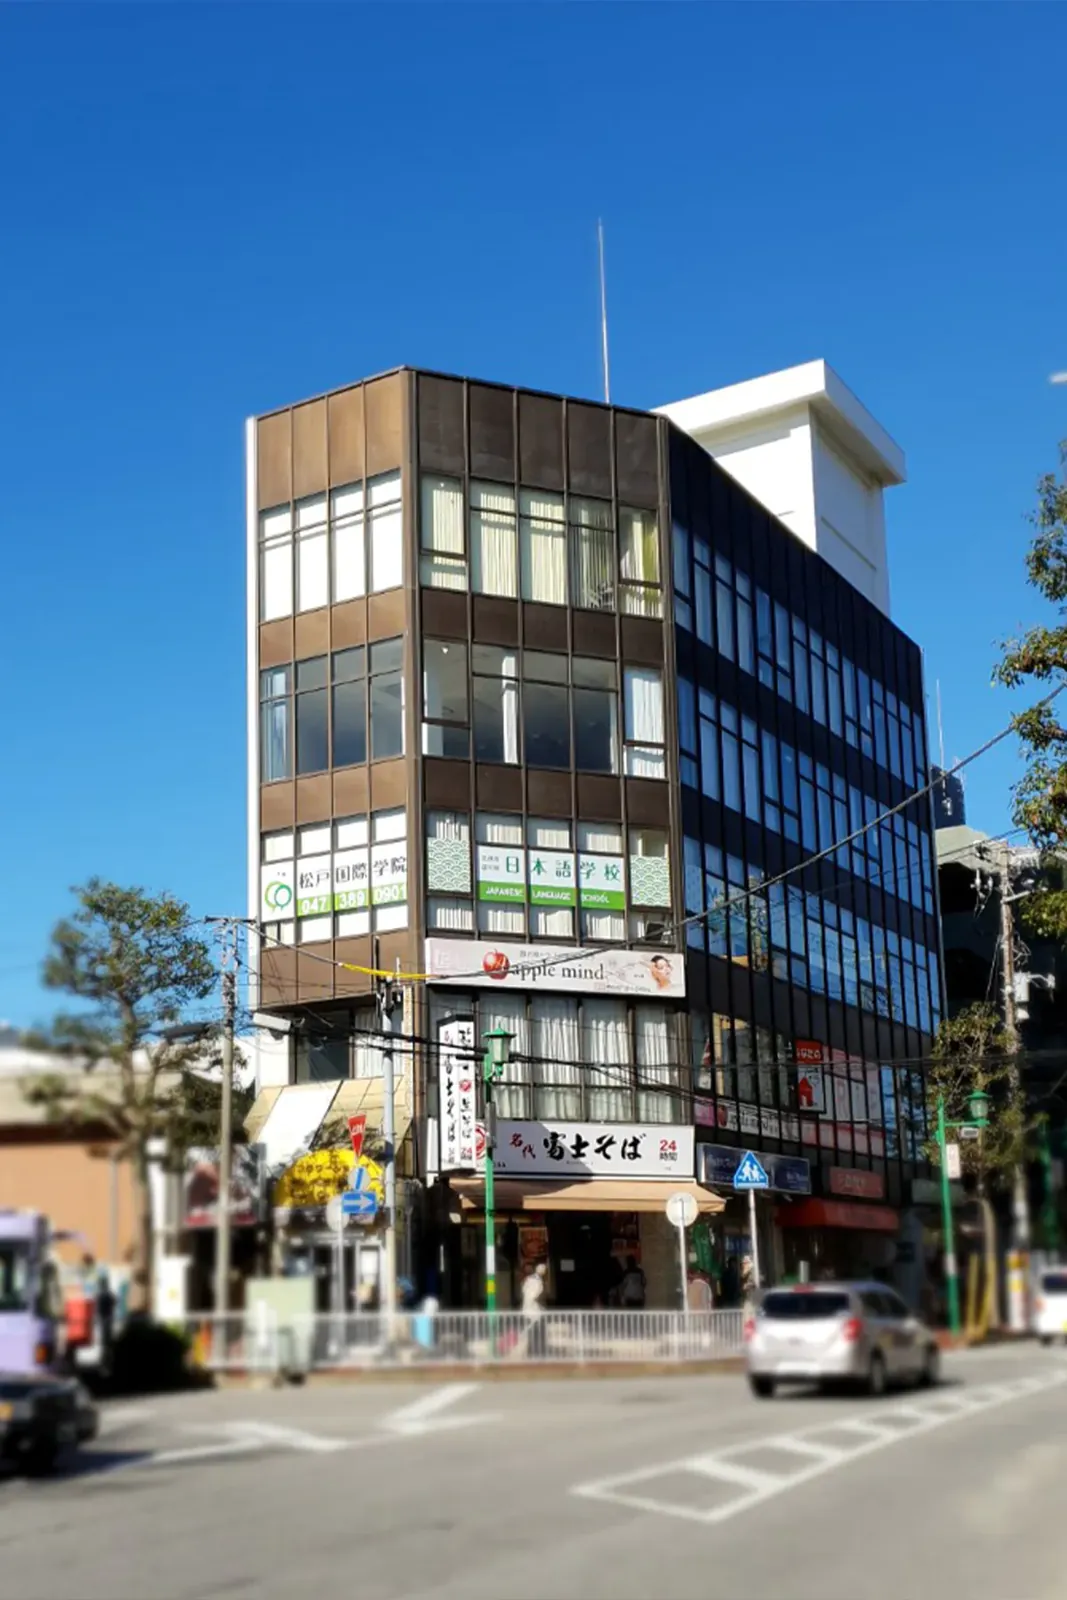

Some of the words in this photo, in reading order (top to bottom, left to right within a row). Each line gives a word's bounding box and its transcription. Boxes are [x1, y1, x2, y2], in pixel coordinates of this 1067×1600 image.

[299, 856, 407, 889] 松戸国際学院
[506, 855, 620, 881] 日本語学校
[301, 896, 328, 915] 047
[532, 890, 571, 901] LANGUAGE
[510, 957, 556, 982] apple
[561, 963, 604, 981] mind
[543, 1131, 647, 1161] 富士そば
[660, 1139, 677, 1152] 24
